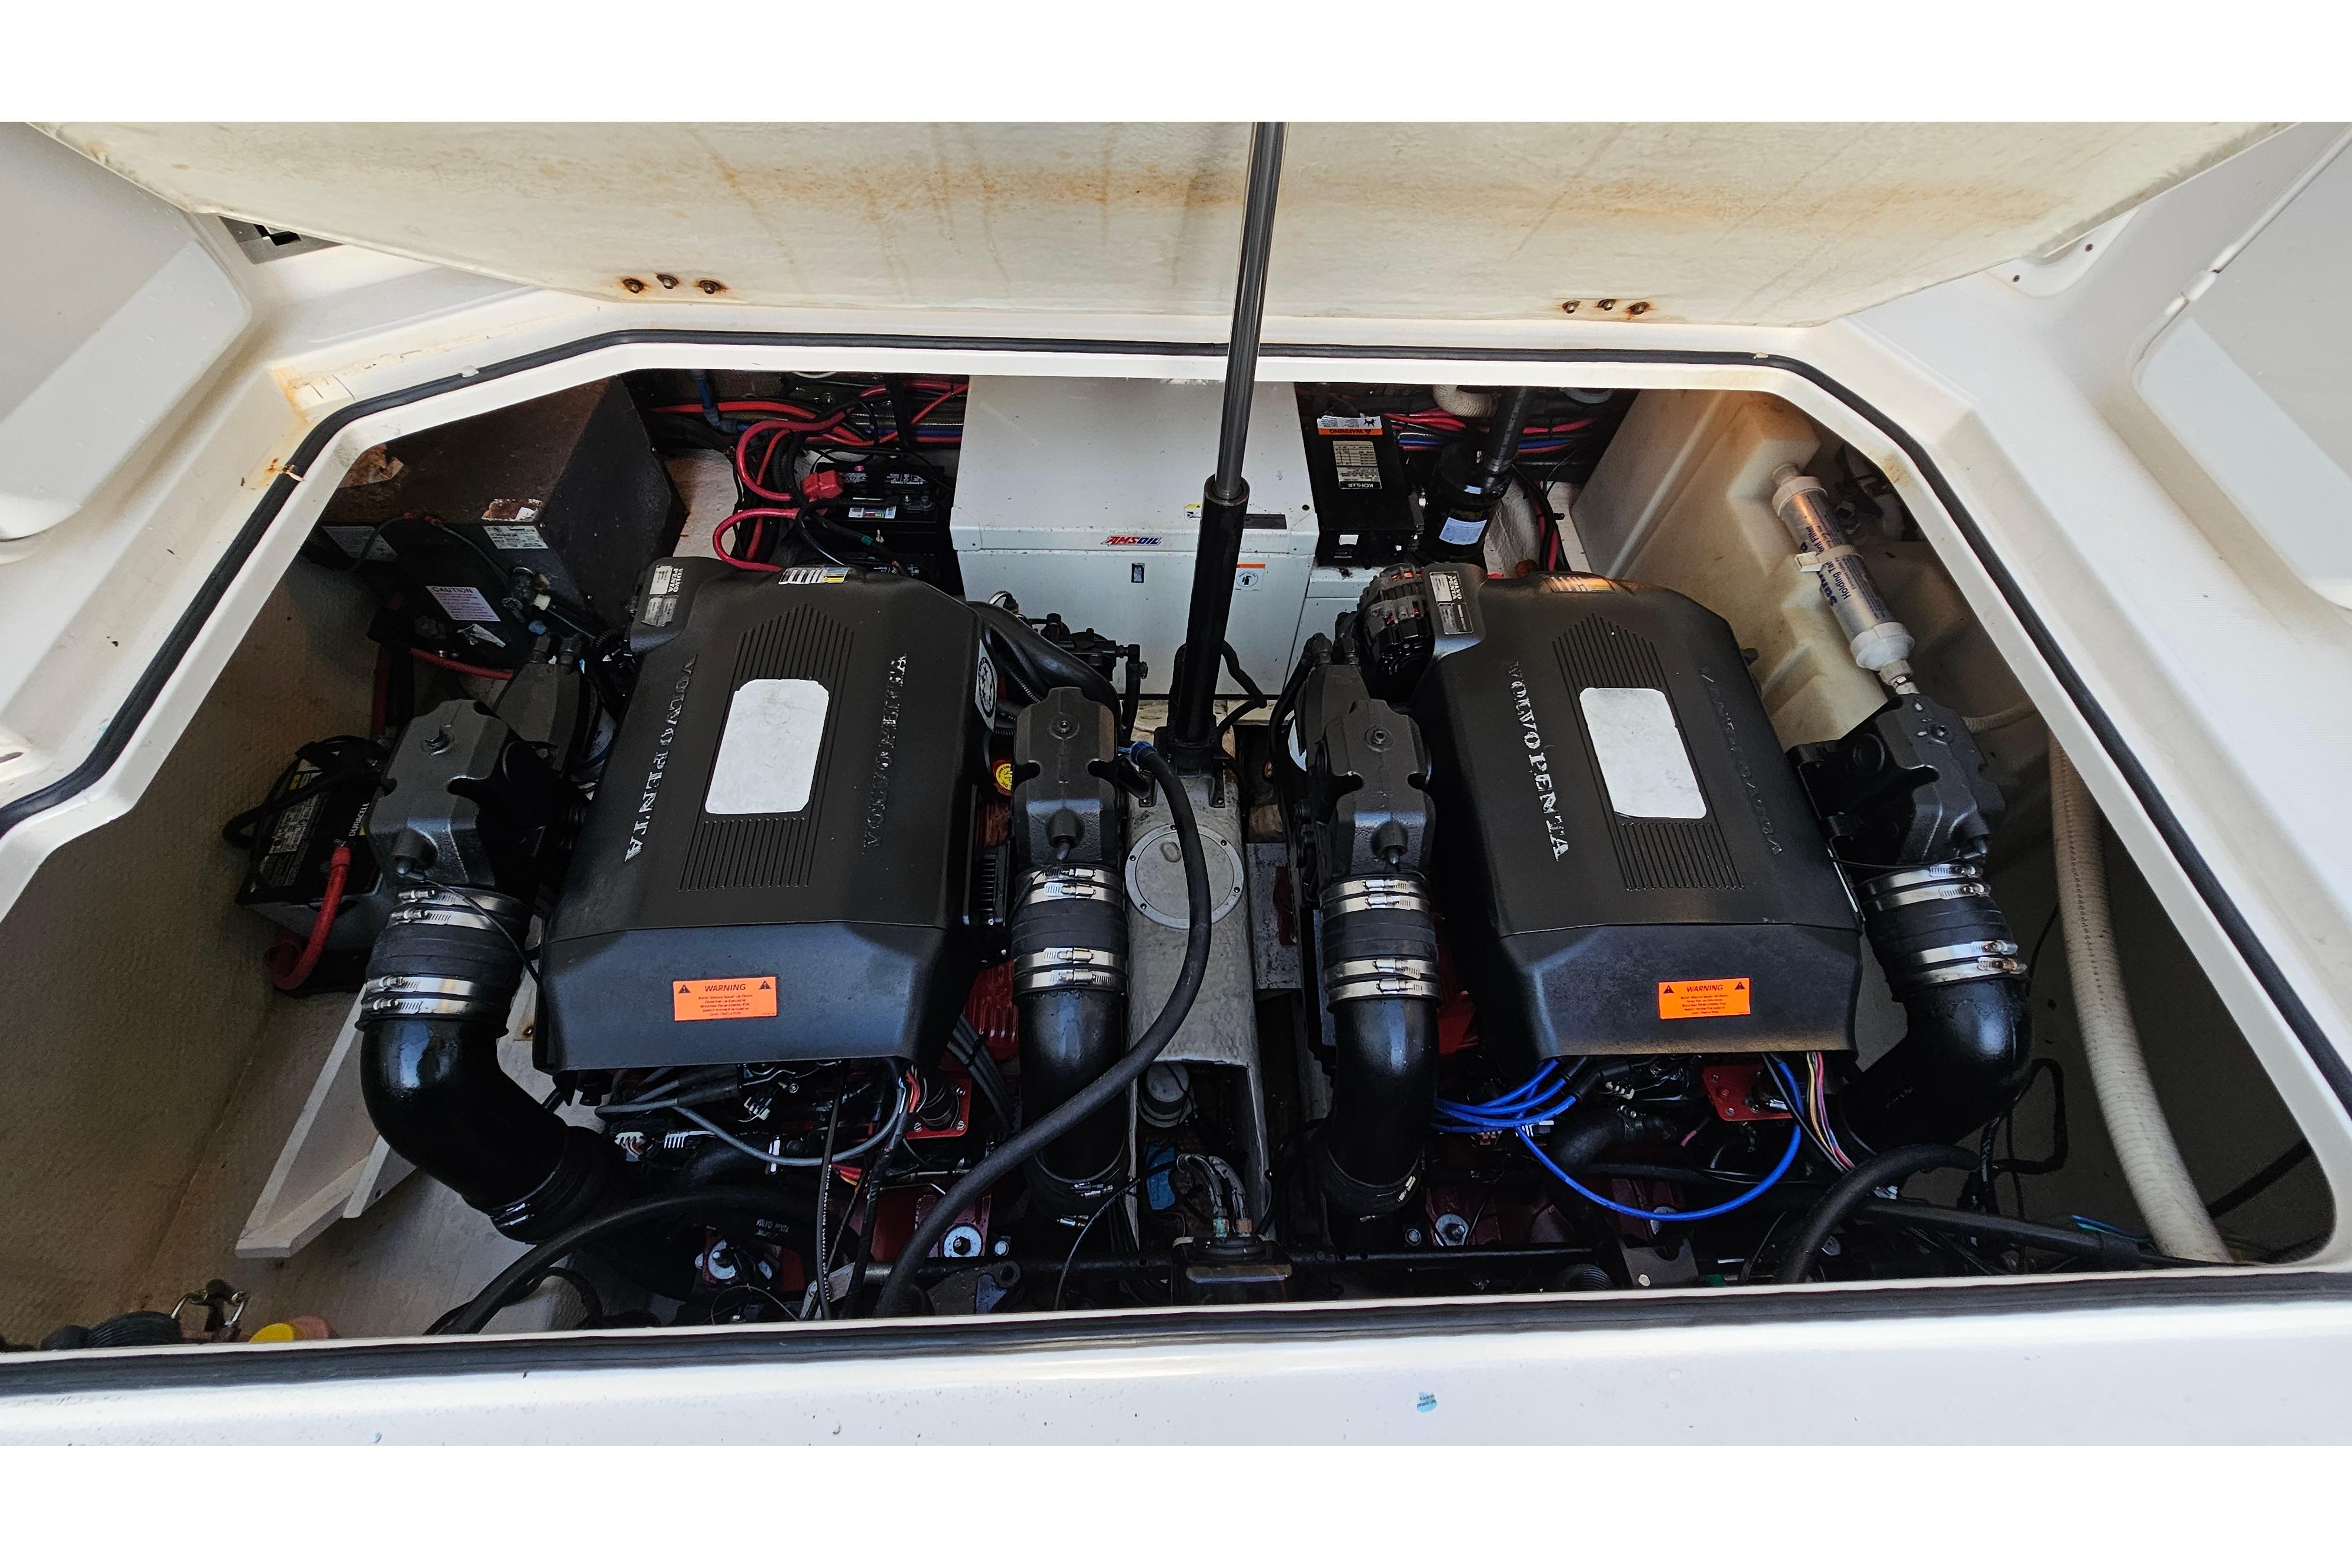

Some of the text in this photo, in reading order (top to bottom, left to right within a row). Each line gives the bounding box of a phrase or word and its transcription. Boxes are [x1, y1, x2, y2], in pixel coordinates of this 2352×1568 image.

[1105, 536, 1160, 546] AMSOIL
[1806, 525, 1819, 541] Filter
[668, 568, 679, 593] PENTA
[673, 567, 684, 593] VOLVO
[1448, 576, 1458, 600] PENTA
[1452, 575, 1462, 600] VOLVO
[1832, 571, 1852, 599] Holding
[659, 654, 699, 746] VOLVO
[1507, 660, 1569, 862] VOLVO PENTA
[624, 750, 670, 862] PENTA
[348, 802, 370, 837] DURACELL
[704, 984, 746, 992] WARNING
[1686, 984, 1723, 992] WARNING
